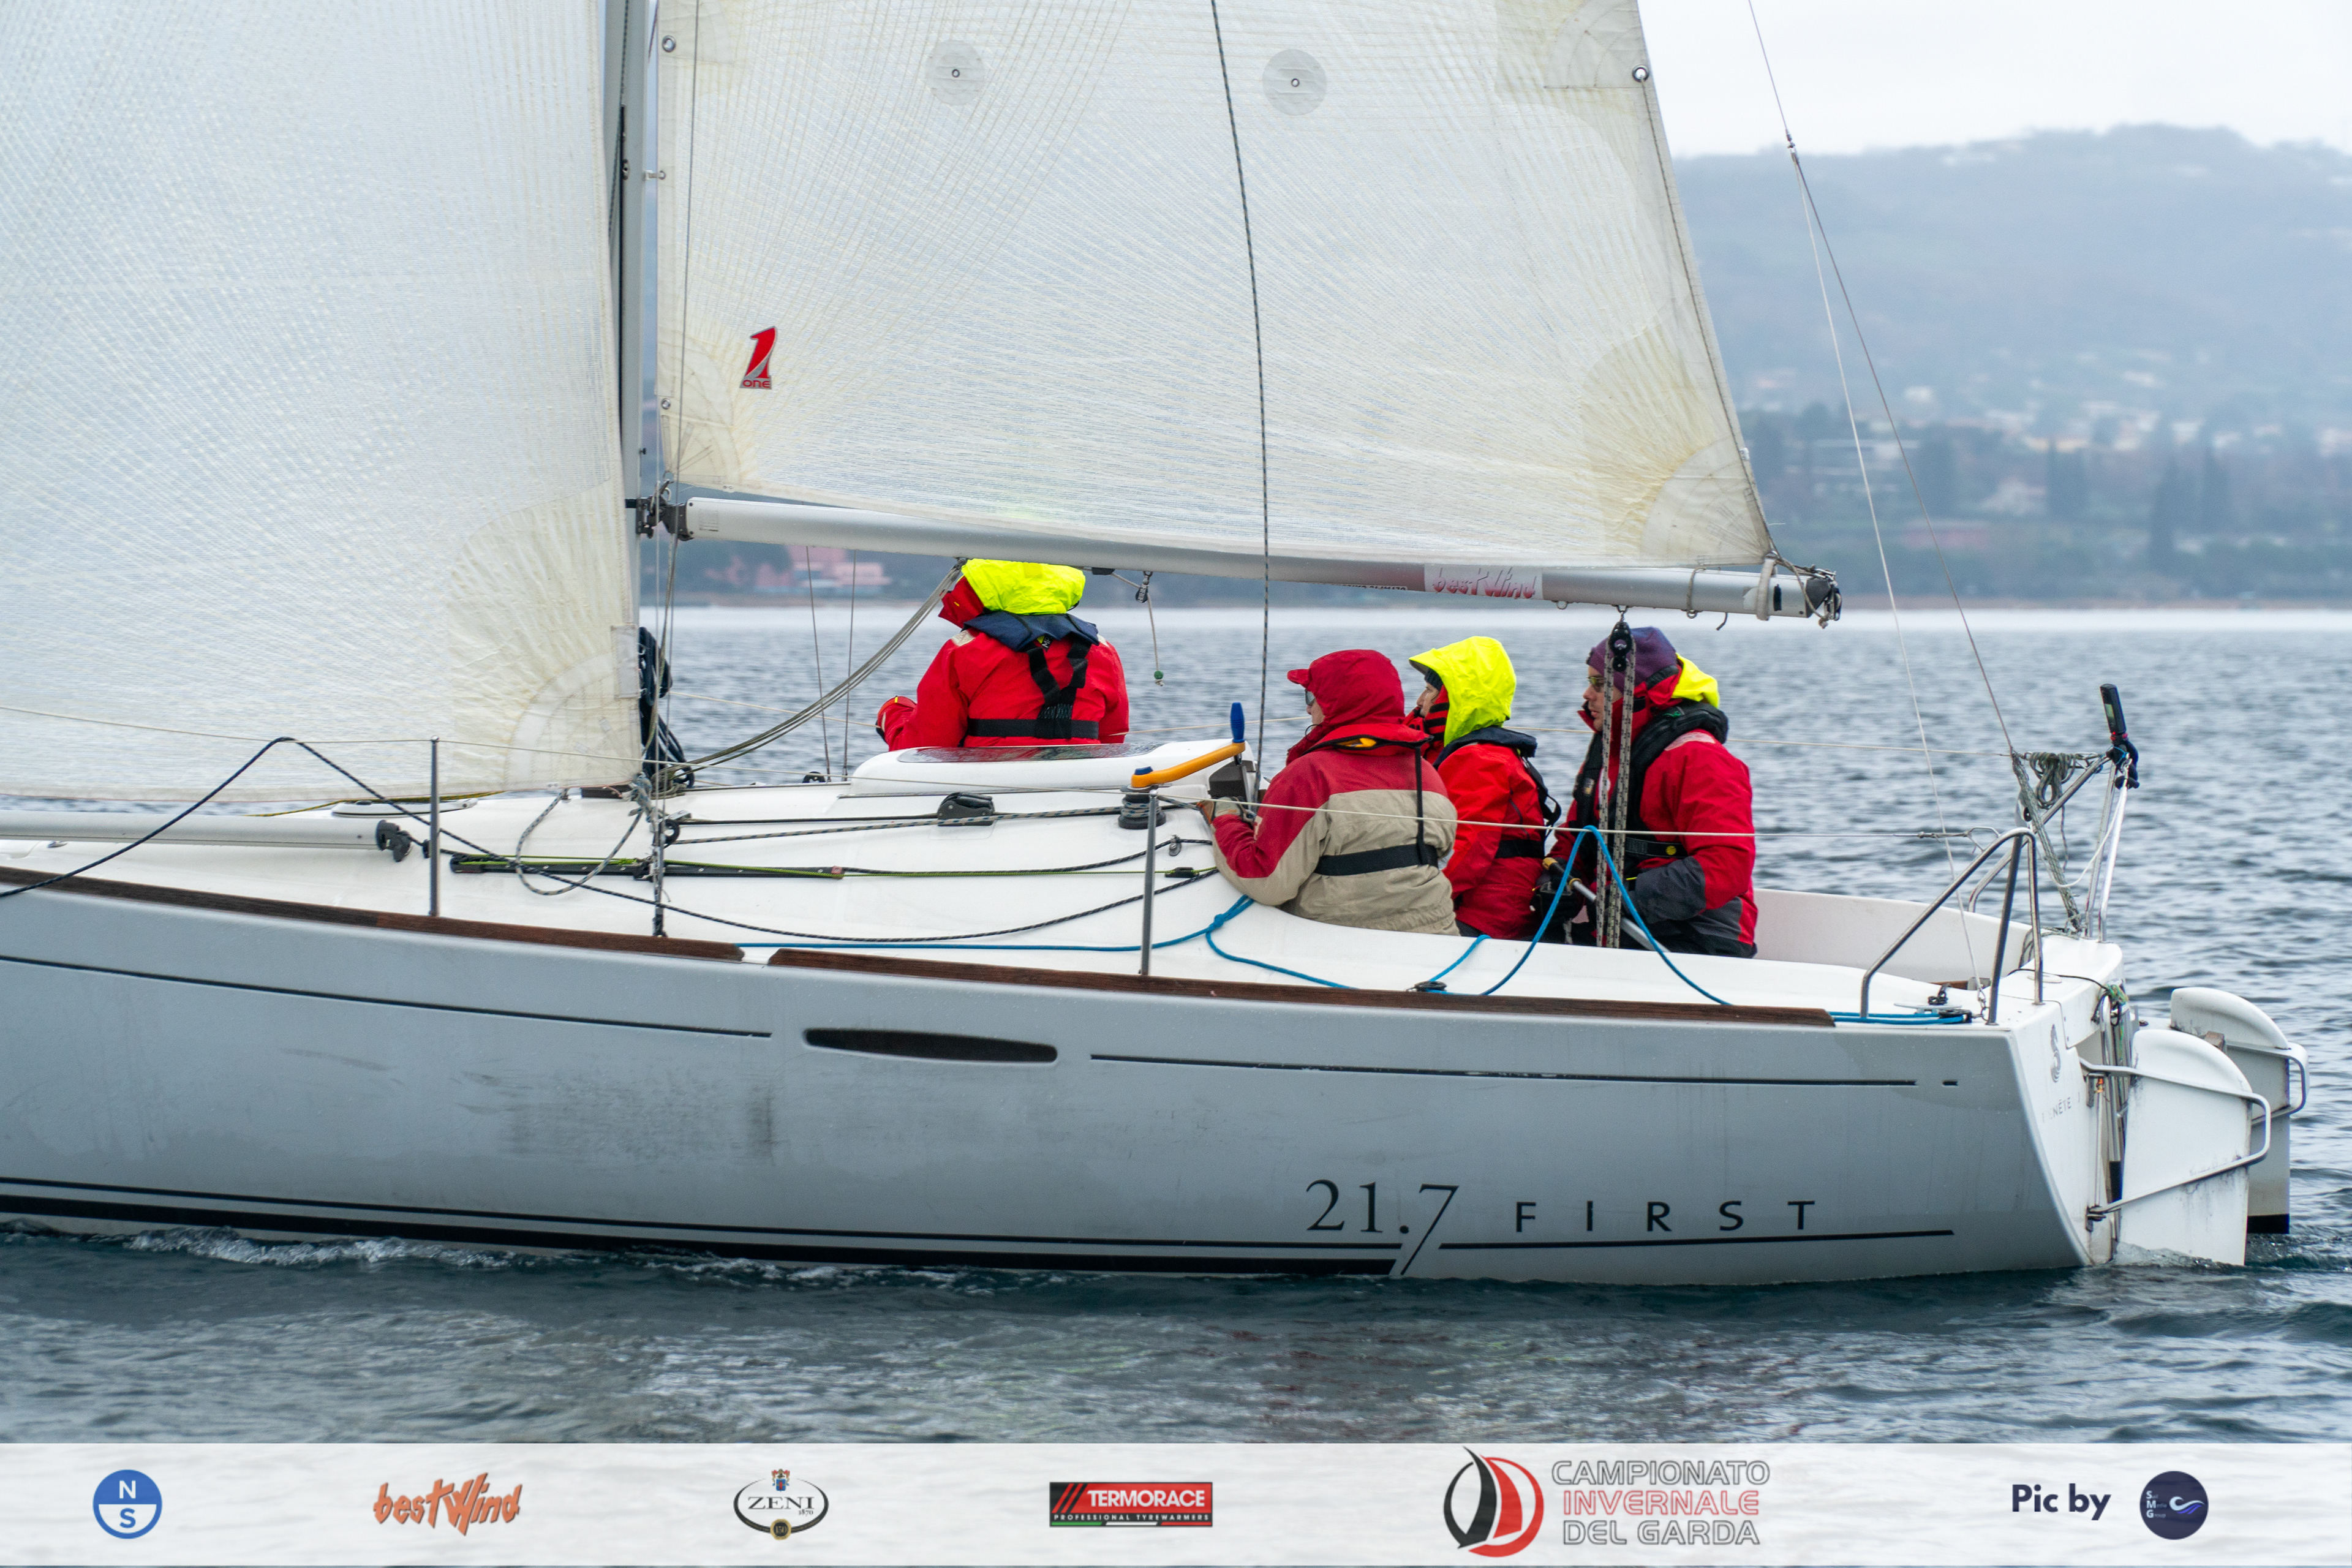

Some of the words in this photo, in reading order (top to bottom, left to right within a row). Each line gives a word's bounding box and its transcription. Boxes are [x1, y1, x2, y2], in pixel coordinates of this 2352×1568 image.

[742, 380, 771, 388] ONE
[1305, 1178, 1459, 1275] 21.7
[1516, 1199, 1815, 1232] FIRST
